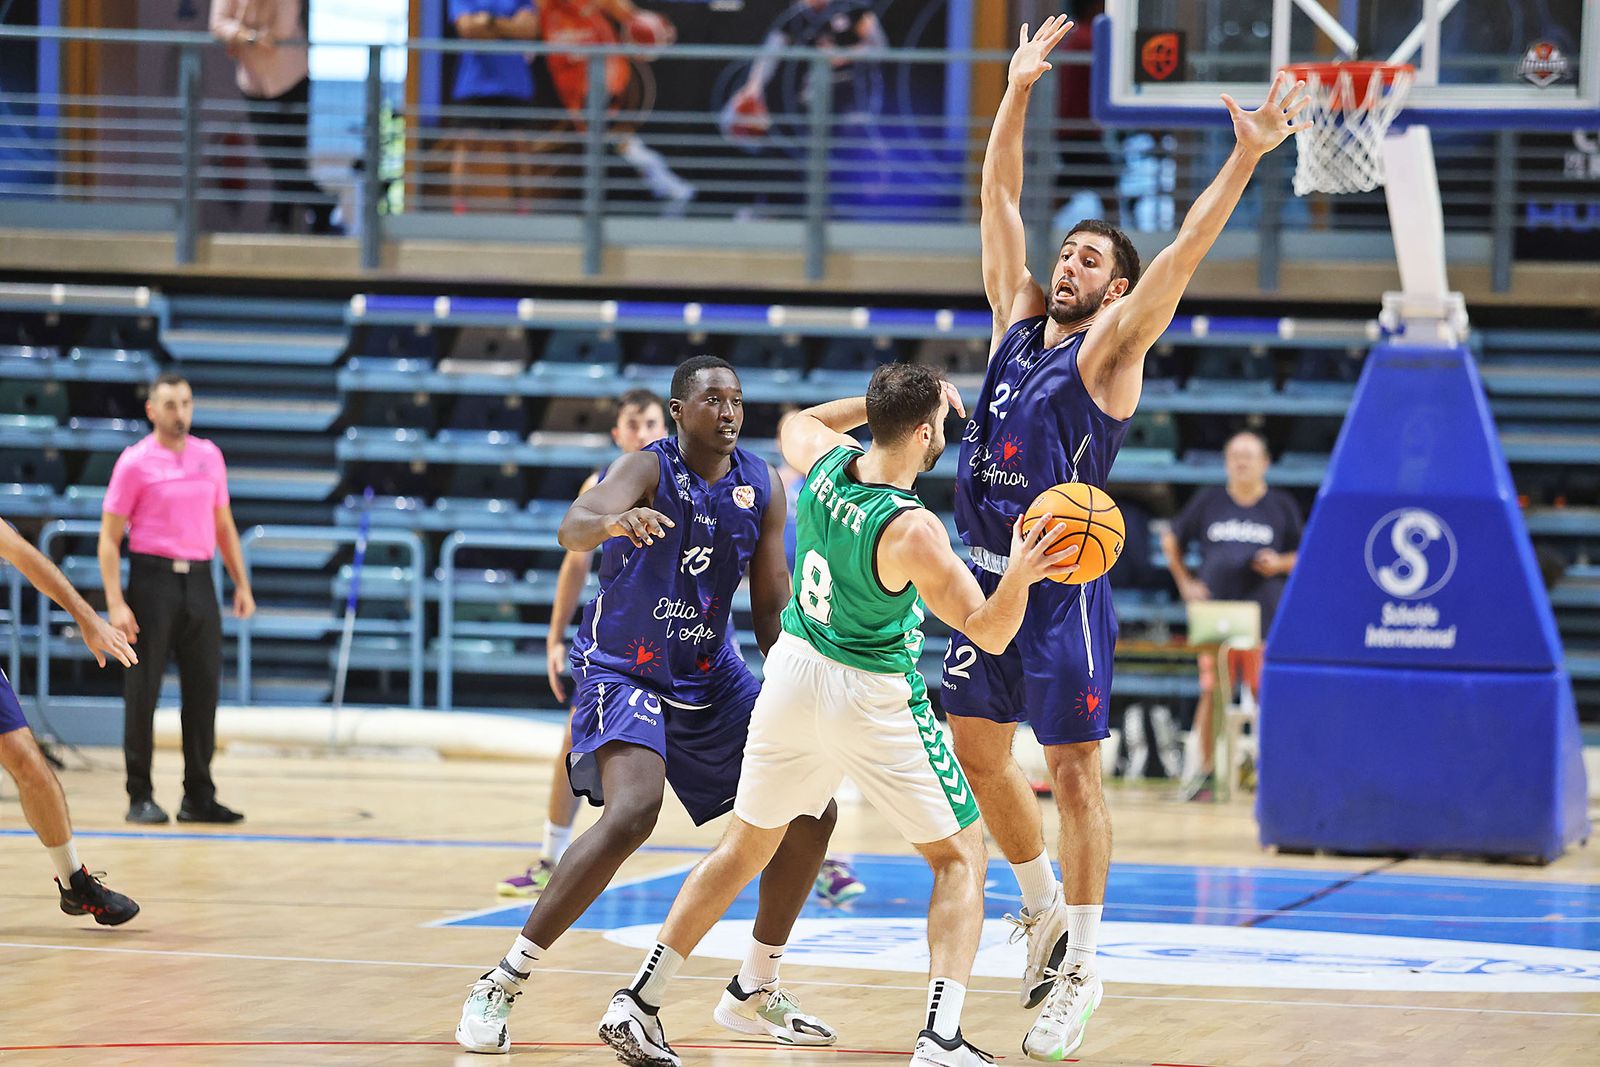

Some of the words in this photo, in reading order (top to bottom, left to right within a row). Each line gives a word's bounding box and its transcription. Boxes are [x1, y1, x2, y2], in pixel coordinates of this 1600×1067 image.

[981, 462, 1029, 488] Amor
[800, 549, 834, 628] 8
[1364, 623, 1458, 650] International
